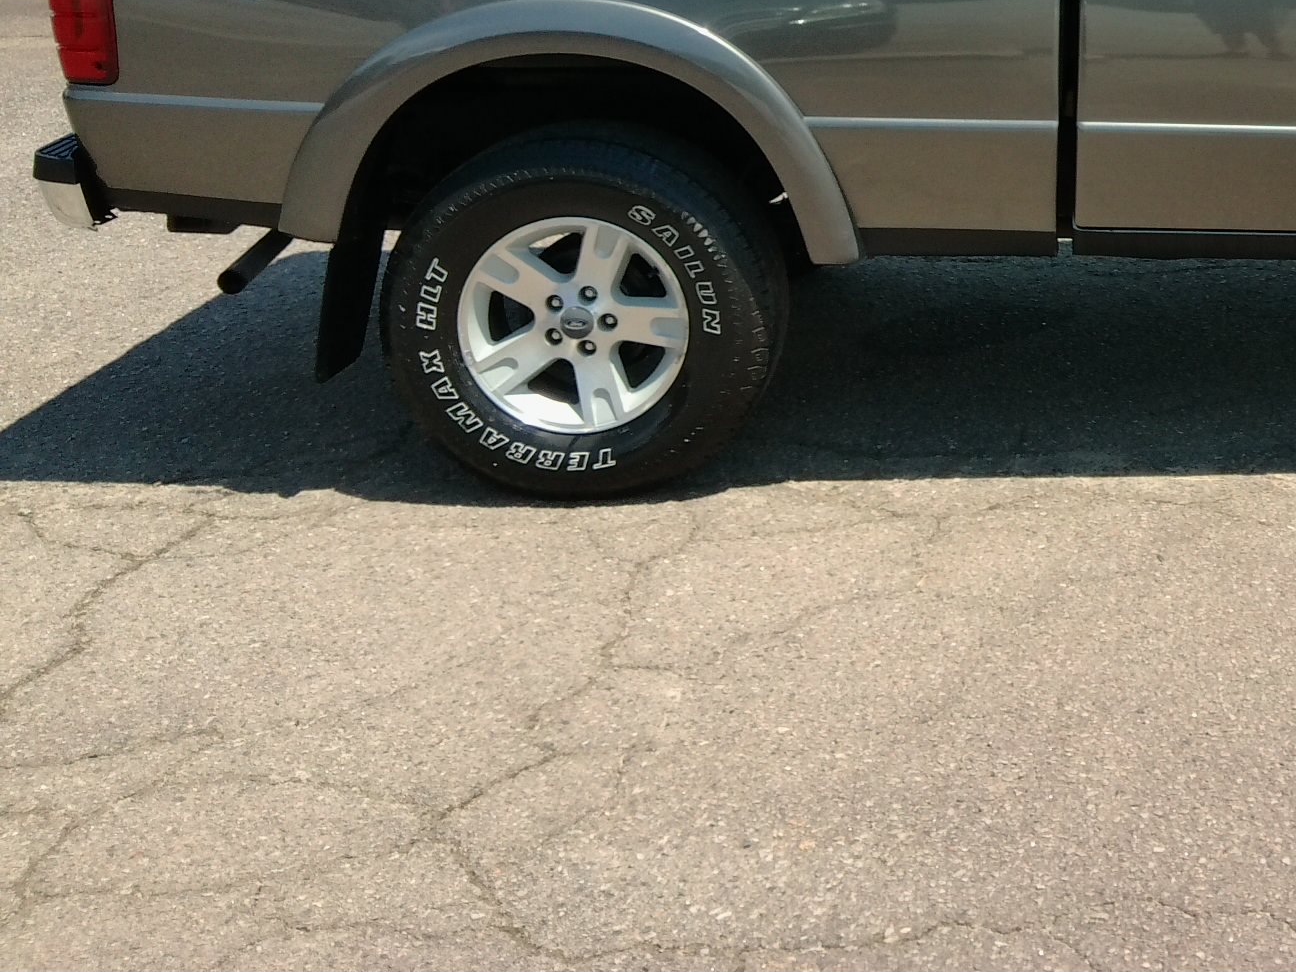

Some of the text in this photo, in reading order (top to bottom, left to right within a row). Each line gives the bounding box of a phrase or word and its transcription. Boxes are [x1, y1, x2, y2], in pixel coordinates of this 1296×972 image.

[628, 204, 722, 335] SAILUN
[415, 257, 617, 472] TERRAMAX HLT
